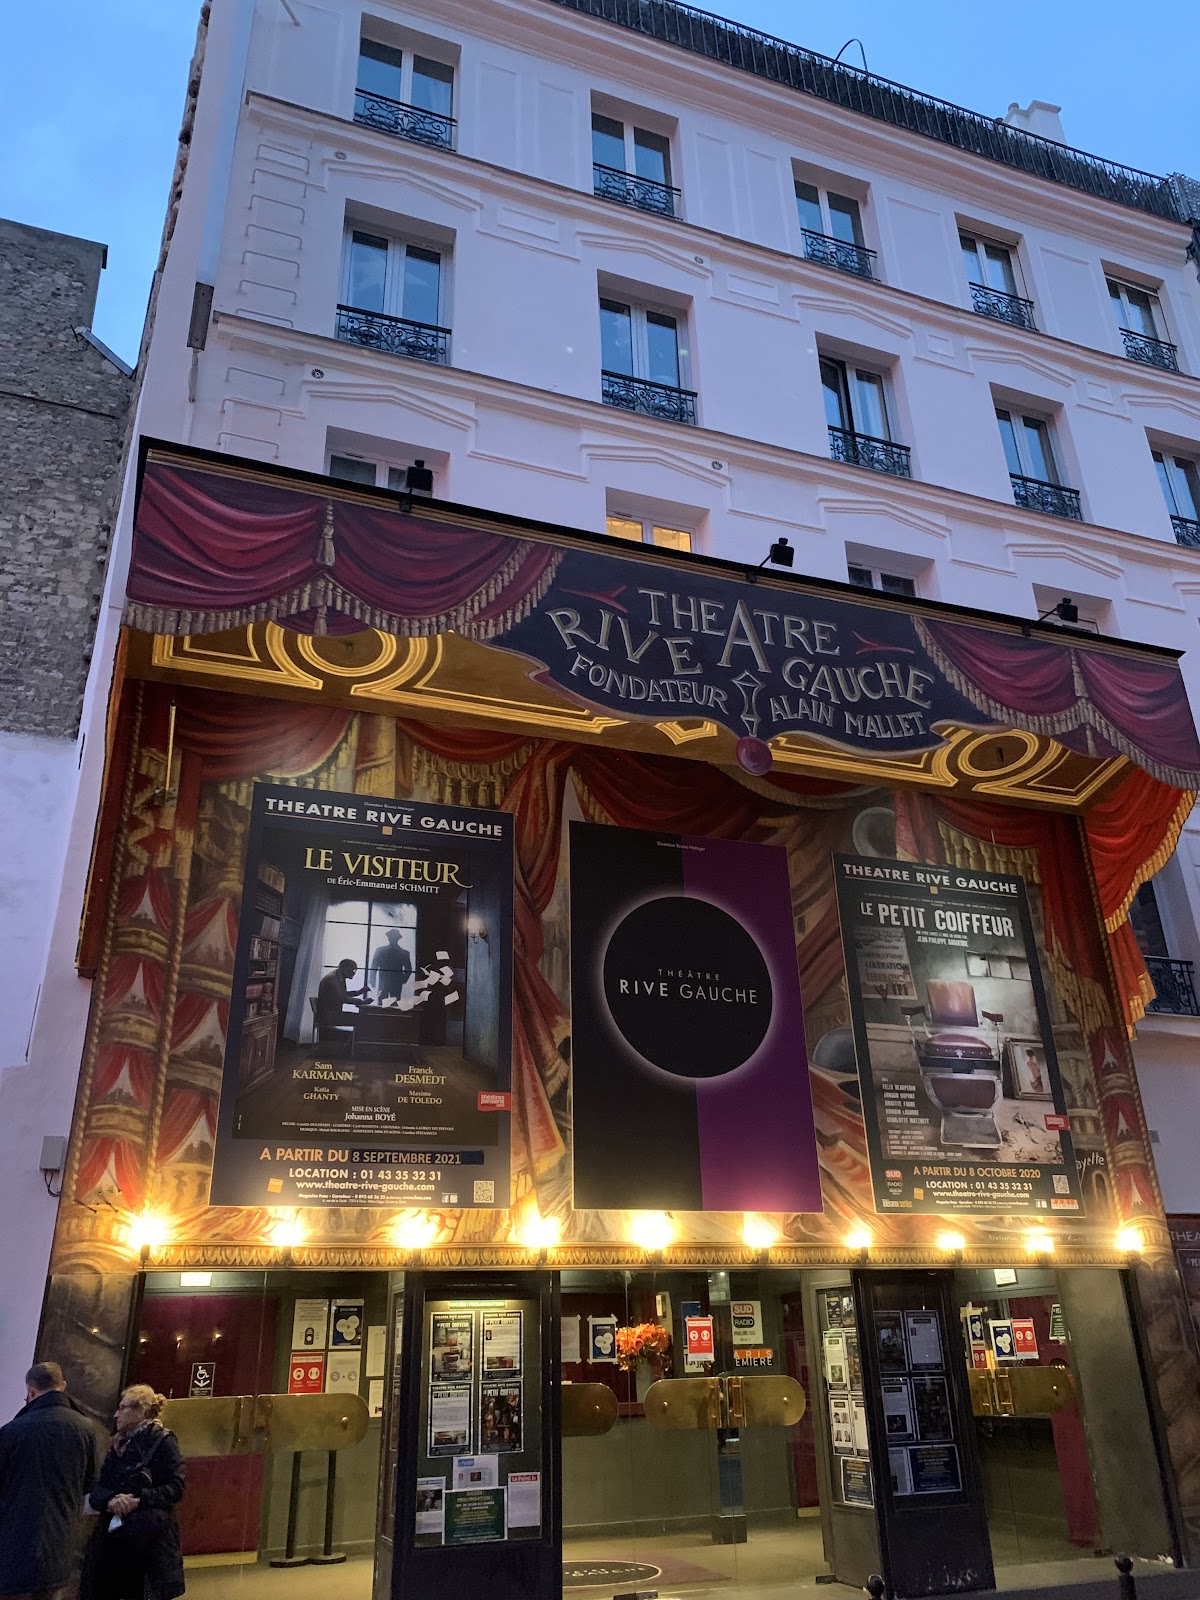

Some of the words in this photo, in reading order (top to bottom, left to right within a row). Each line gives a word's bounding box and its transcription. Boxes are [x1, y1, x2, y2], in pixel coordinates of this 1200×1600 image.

[638, 588, 841, 673] THEATRE
[546, 608, 703, 675] RIVE
[782, 656, 936, 708] GAUCHE
[570, 652, 729, 715] FONDATEUR
[770, 696, 835, 727] ALAIN
[844, 711, 926, 738] MALLET
[266, 798, 357, 820] THEATRE
[366, 809, 412, 826] RIVE
[420, 816, 502, 836] GAUCHE
[304, 848, 333, 870] LE
[342, 852, 474, 888] VISITEUR
[338, 875, 398, 890] Éric-Emmanuel
[399, 882, 440, 894] SCHMITT
[843, 864, 910, 881] THEATRE
[916, 872, 950, 886] RIVE
[955, 877, 1018, 894] GAUCHE
[860, 902, 873, 916] LE
[878, 903, 925, 928] PETIT
[934, 910, 1014, 938] COIFFEUR
[658, 968, 720, 981] THÉÂTRE
[620, 979, 669, 997] RIVE
[680, 984, 757, 1004] GAUCHE
[314, 1061, 332, 1070] Sam
[408, 1066, 434, 1074] Franck
[292, 1070, 353, 1081] KARMANN
[395, 1074, 447, 1085] DESMEDT
[345, 1113, 373, 1122] Johanna
[374, 1113, 396, 1122] BOYÉ
[260, 1148, 271, 1160] A
[276, 1148, 323, 1161] PARTIR
[328, 1150, 349, 1162] DU
[353, 1152, 360, 1162] 8
[363, 1151, 432, 1164] SEPTEMBRE
[435, 1154, 460, 1164] 2021
[289, 1168, 348, 1178] LOCATION
[360, 1170, 373, 1179] 01
[378, 1170, 391, 1180] 43
[395, 1170, 408, 1180] 35
[412, 1171, 426, 1180] 32
[429, 1171, 441, 1180] 31
[913, 1166, 920, 1175] A
[922, 1166, 952, 1176] PARTIR
[954, 1167, 966, 1176] DU
[969, 1167, 975, 1176] 8
[977, 1168, 1017, 1177] OCTOBRE
[1019, 1169, 1040, 1178] 2020
[296, 1180, 435, 1192] www.theatre-rive-gauche.com
[926, 1181, 967, 1189] LOCATION
[933, 1190, 1030, 1199] www.theatre-rive-gauche.com
[734, 1305, 752, 1313] SUD
